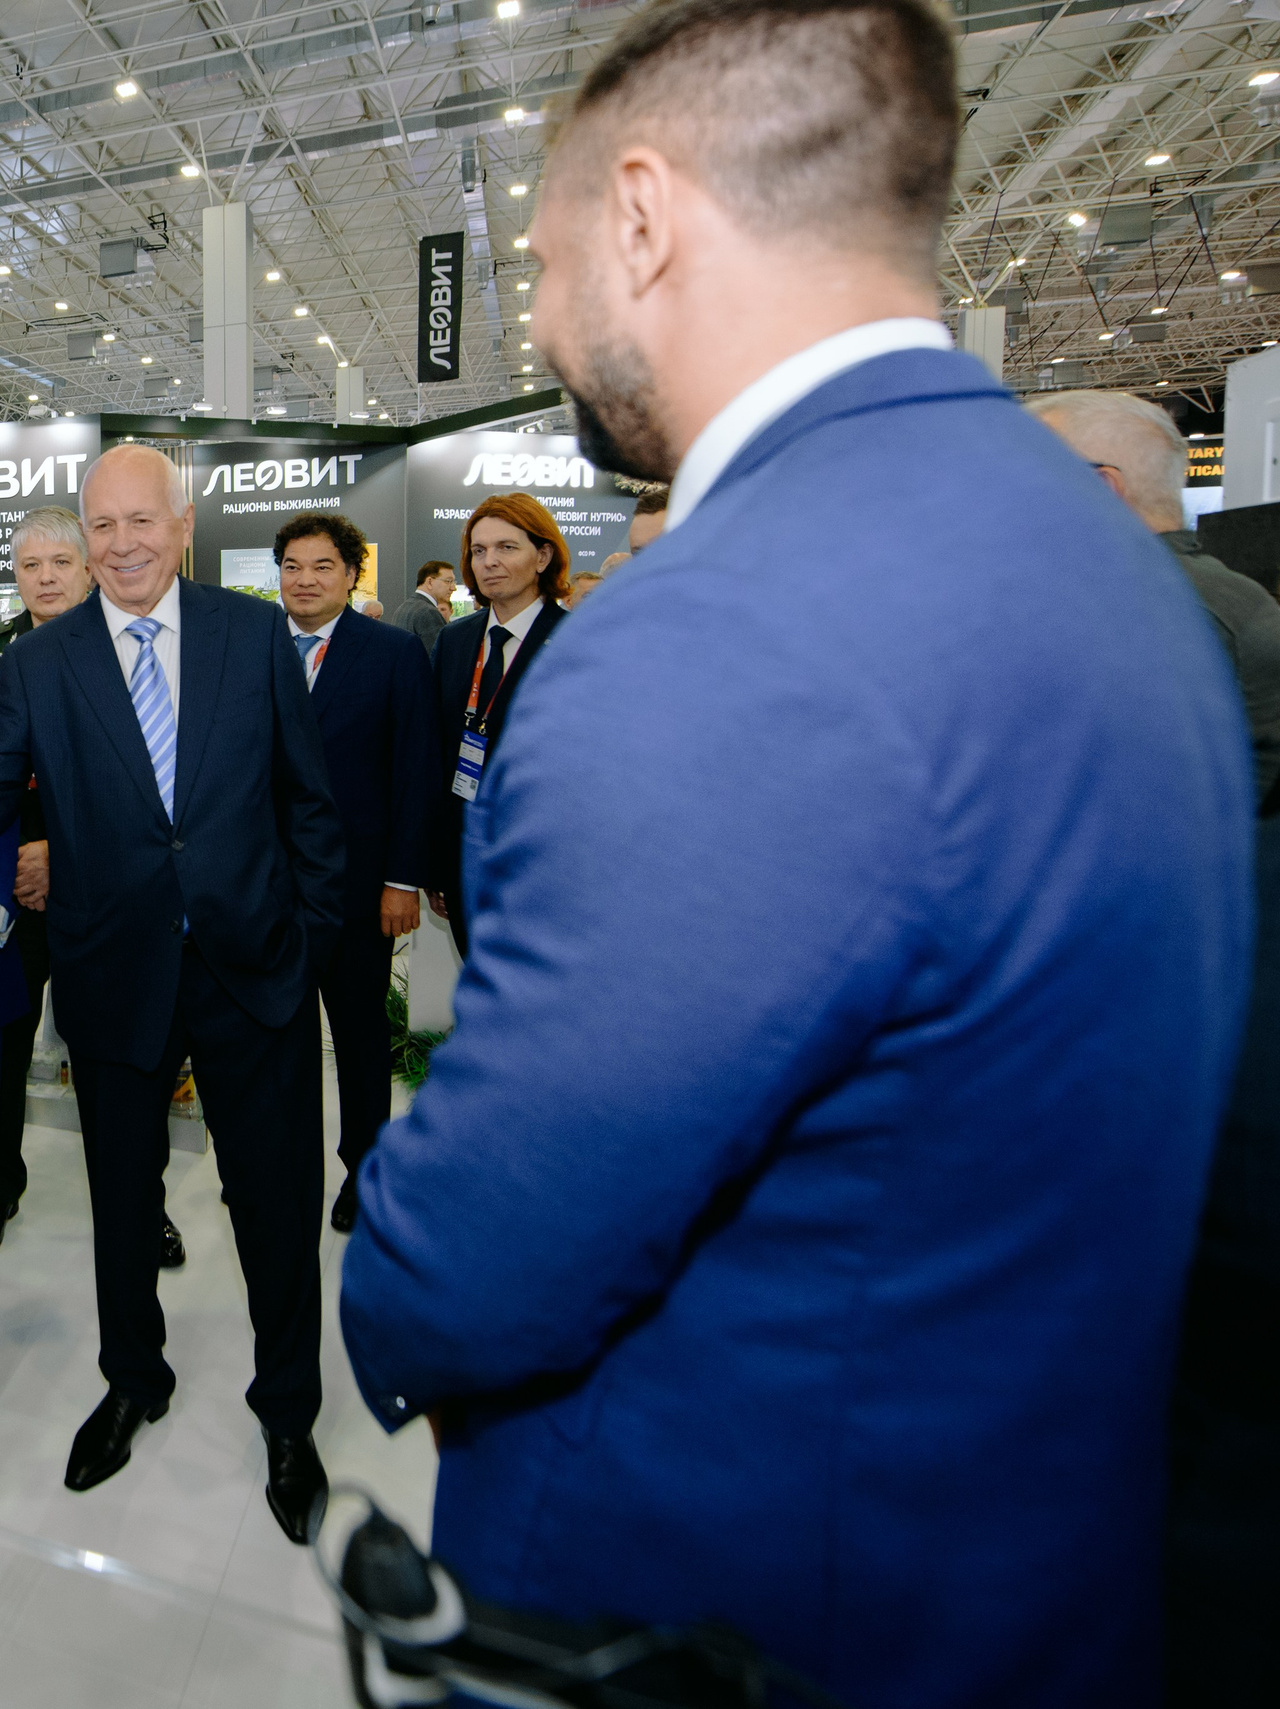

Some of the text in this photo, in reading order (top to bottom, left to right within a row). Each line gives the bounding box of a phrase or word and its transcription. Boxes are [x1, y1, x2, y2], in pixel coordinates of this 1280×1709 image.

[429, 247, 453, 370] ЛЕОВИТ
[202, 454, 363, 497] ЛЕОВИТ
[223, 497, 341, 515] РАЦИОНЫ ВЫЖИВАНИЯ
[590, 512, 627, 523] НУТРИО»
[569, 525, 601, 536] РОССИИ
[0, 560, 13, 571] РФ
